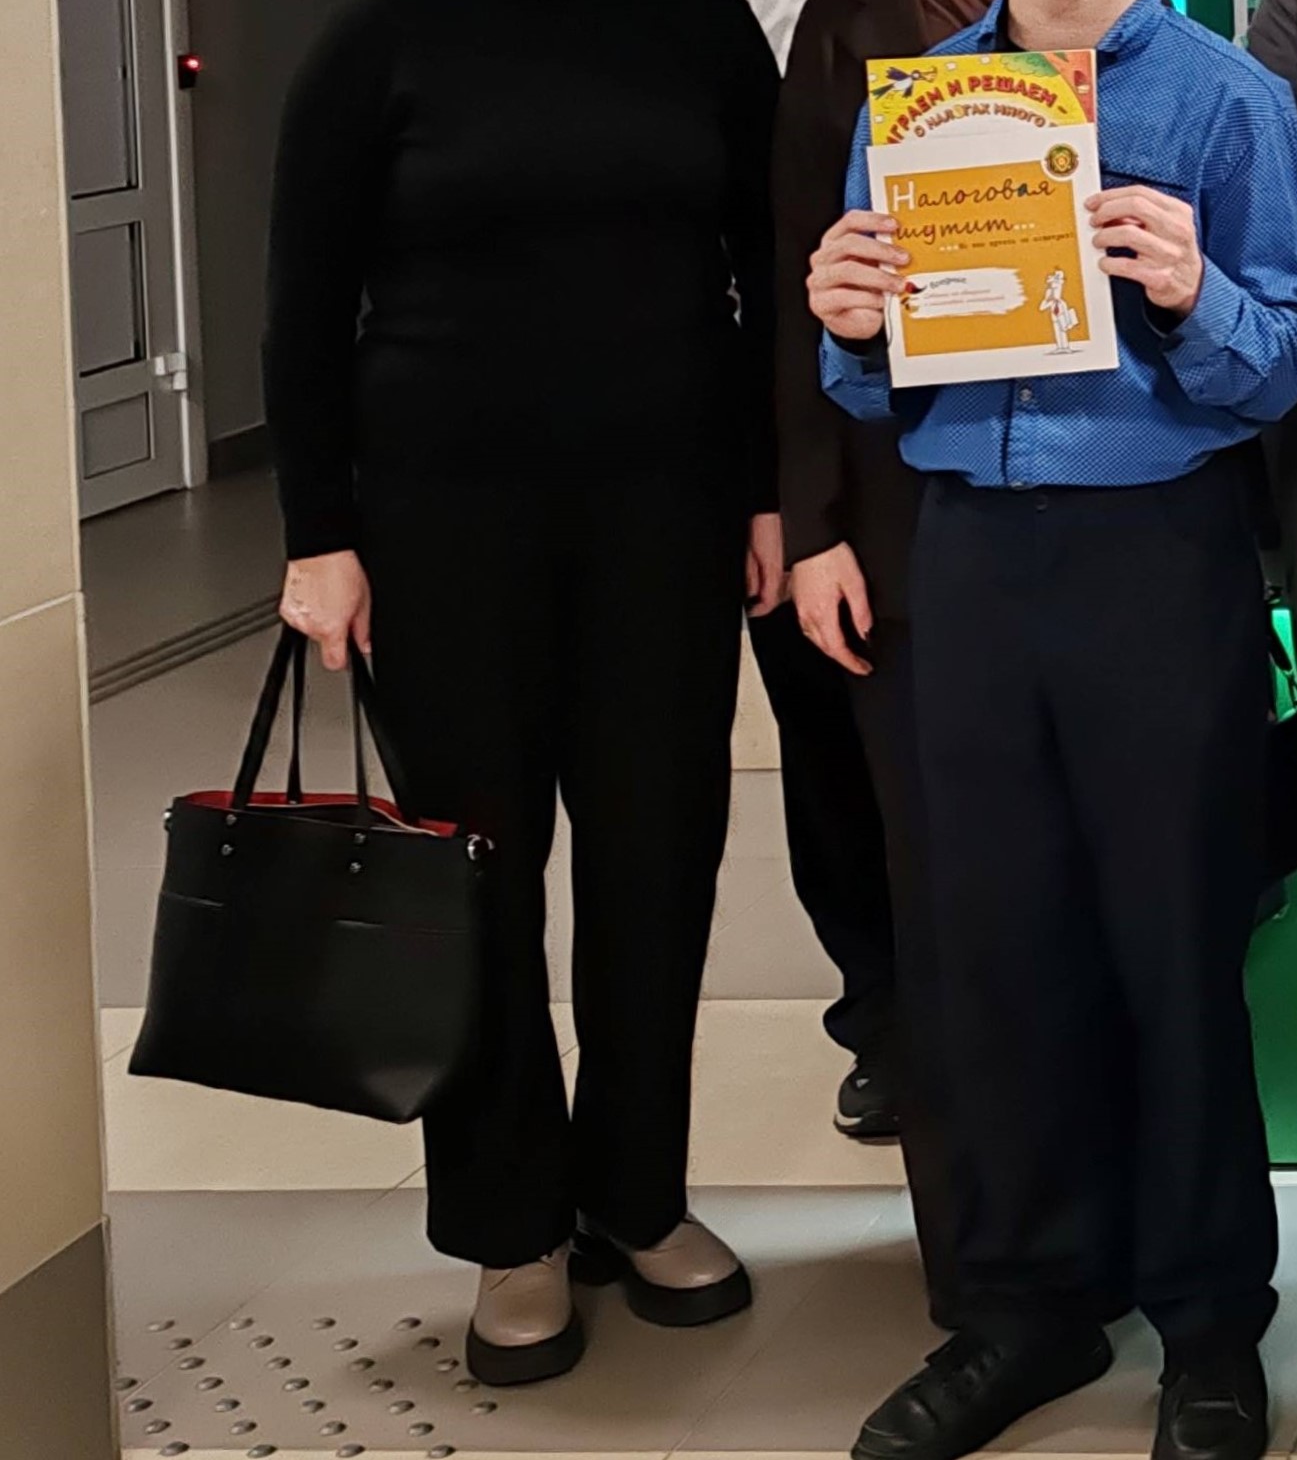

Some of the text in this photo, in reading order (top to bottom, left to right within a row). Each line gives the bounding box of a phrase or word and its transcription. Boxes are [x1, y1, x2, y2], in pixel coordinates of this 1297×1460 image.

[947, 80, 963, 97] И
[967, 75, 1058, 108] РЕШАЕМ
[925, 103, 990, 131] НАЛОГАХ
[994, 103, 1046, 128] МНОГО
[892, 178, 1056, 213] Налоговая
